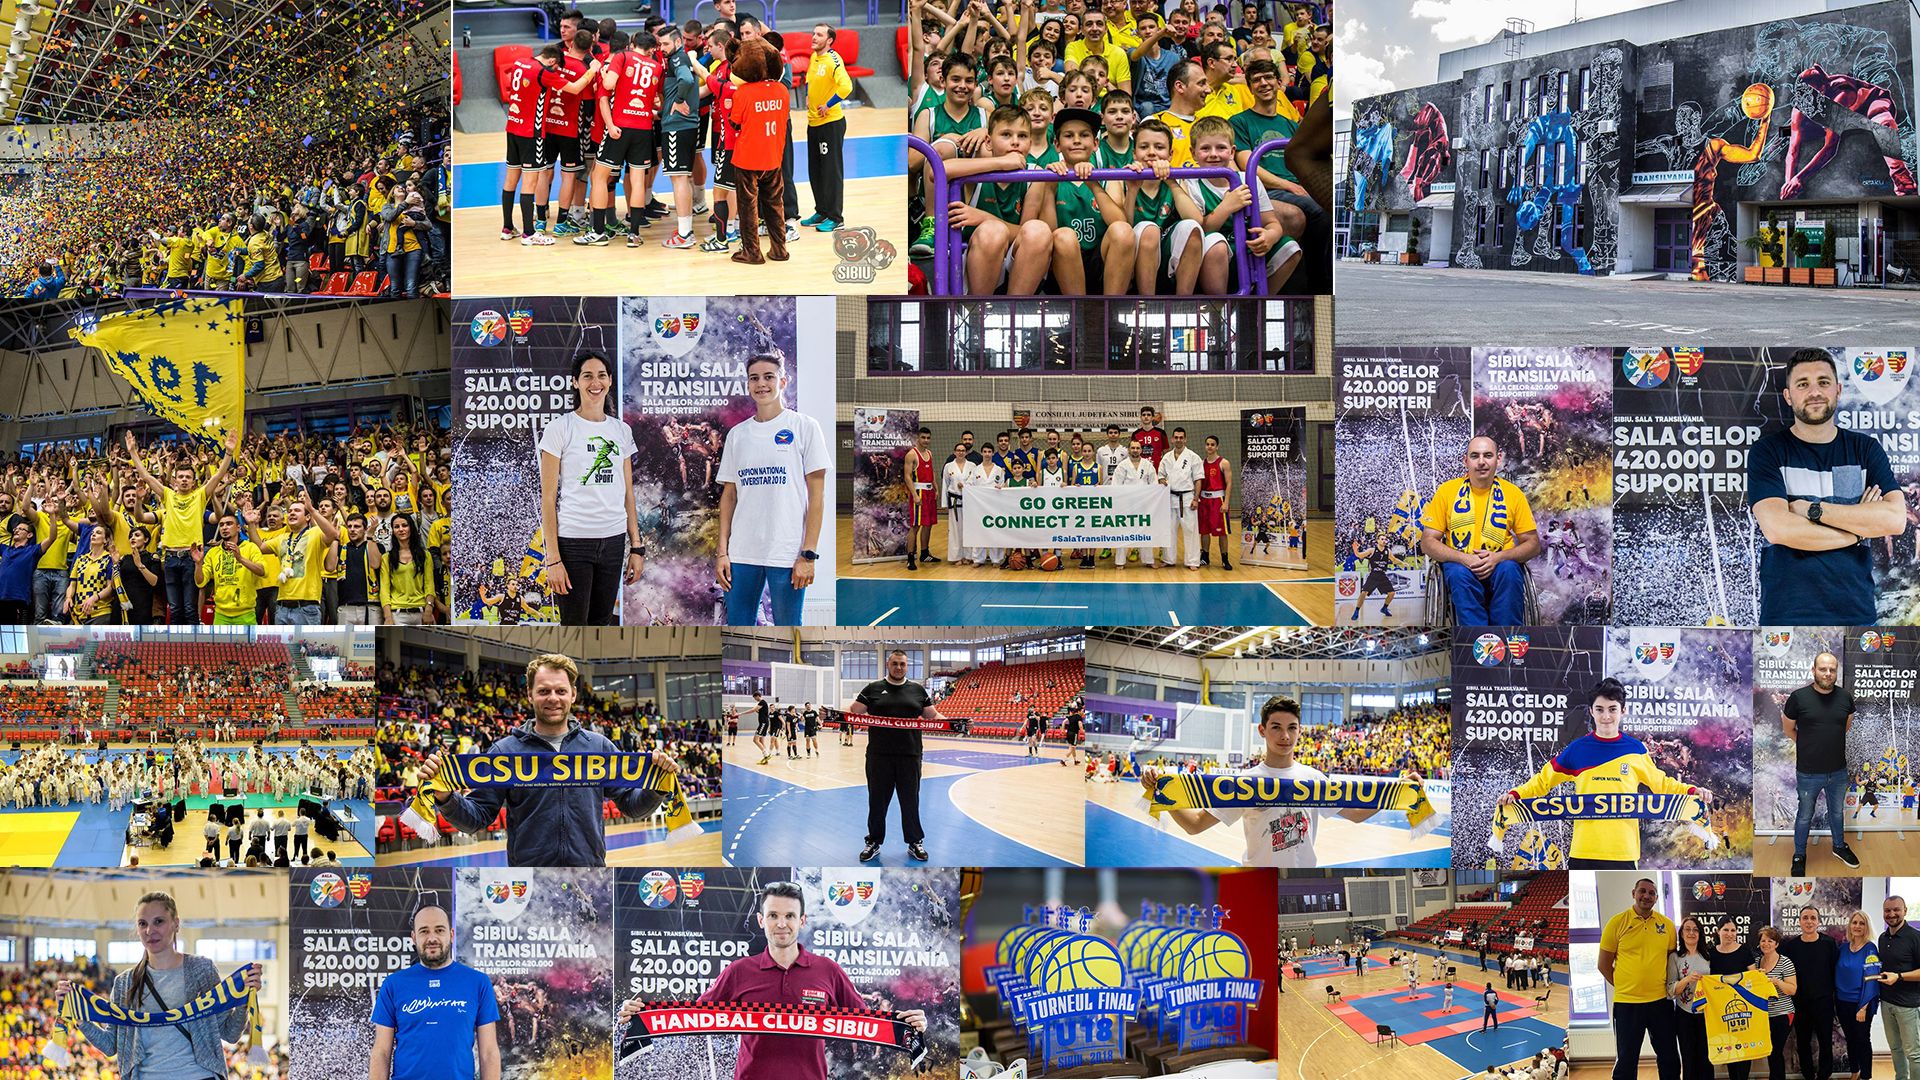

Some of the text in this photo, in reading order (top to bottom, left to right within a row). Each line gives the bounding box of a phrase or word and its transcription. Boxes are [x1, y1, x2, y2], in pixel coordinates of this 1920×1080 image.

[512, 69, 522, 91] 8
[633, 63, 653, 88] 18
[755, 100, 782, 112] BUBU
[765, 121, 776, 136] 10
[1634, 173, 1694, 182] TRANSILVANIA
[1072, 218, 1096, 242] 35
[1488, 355, 1573, 367] SIBIU. SALA
[641, 363, 747, 378] SIBIU. SALA
[1343, 365, 1439, 378] SALA CELOR
[1488, 370, 1596, 383] TRANSILVANIA
[465, 377, 511, 392] SALA
[1343, 381, 1436, 394] 420.000 DE
[465, 395, 574, 410] 420.000 DE
[1343, 396, 1431, 409] SUPORTERI
[1839, 411, 1902, 429] SIBIU.
[1144, 436, 1151, 444] 19
[1614, 426, 1760, 446] SALA CELOR
[587, 444, 595, 452] DA
[1614, 450, 1748, 469] 420.000 D
[760, 467, 786, 475] NATIONAL
[772, 476, 786, 484] 2018
[1083, 476, 1091, 485] 14
[1615, 473, 1748, 493] SUPORTERI
[1020, 497, 1113, 510] GO GREEN
[982, 514, 1151, 529] CONNECT 2 EARTH
[1052, 534, 1151, 542] #SalaTransilvaniaSibiu
[1759, 660, 1814, 670] SIBIU. SALA
[1855, 669, 1917, 678] SALA CELOR
[1854, 680, 1914, 688] 420.000 DE
[1625, 686, 1714, 700] SIBIU. SALA
[1854, 690, 1910, 698] SUPORTERI
[1466, 694, 1568, 708] SALA CELOR
[1625, 702, 1740, 717] TRANSILVANIA
[848, 716, 892, 726] HANDBAL
[1465, 711, 1564, 725] 420.000 DE
[1466, 727, 1558, 741] SUPORTERI
[468, 755, 646, 783] CSU SIBIU
[1211, 776, 1378, 803] CSU SIBIU
[1532, 795, 1666, 816] CSU SIBIU
[473, 926, 571, 941] SIBIU. SALA
[814, 930, 920, 947] SIBIU. SALA
[303, 937, 415, 951] SALA CELOR
[473, 943, 597, 959] TRANSILVANIA
[631, 939, 749, 956] SALA CELOR
[303, 955, 411, 969] 420.000 DE
[630, 958, 711, 975] 420.000
[866, 968, 900, 976] 420.000
[1169, 981, 1256, 1006] TURNEUL FINAL
[1028, 992, 1094, 1021] TURNEUL
[1098, 992, 1136, 1012] FINAL
[1190, 1005, 1237, 1030] U18
[651, 1013, 879, 1038] HANDBAL CLUB SIBIU
[1056, 1017, 1113, 1047] U18
[1058, 1050, 1113, 1069] SIBIU 2018
